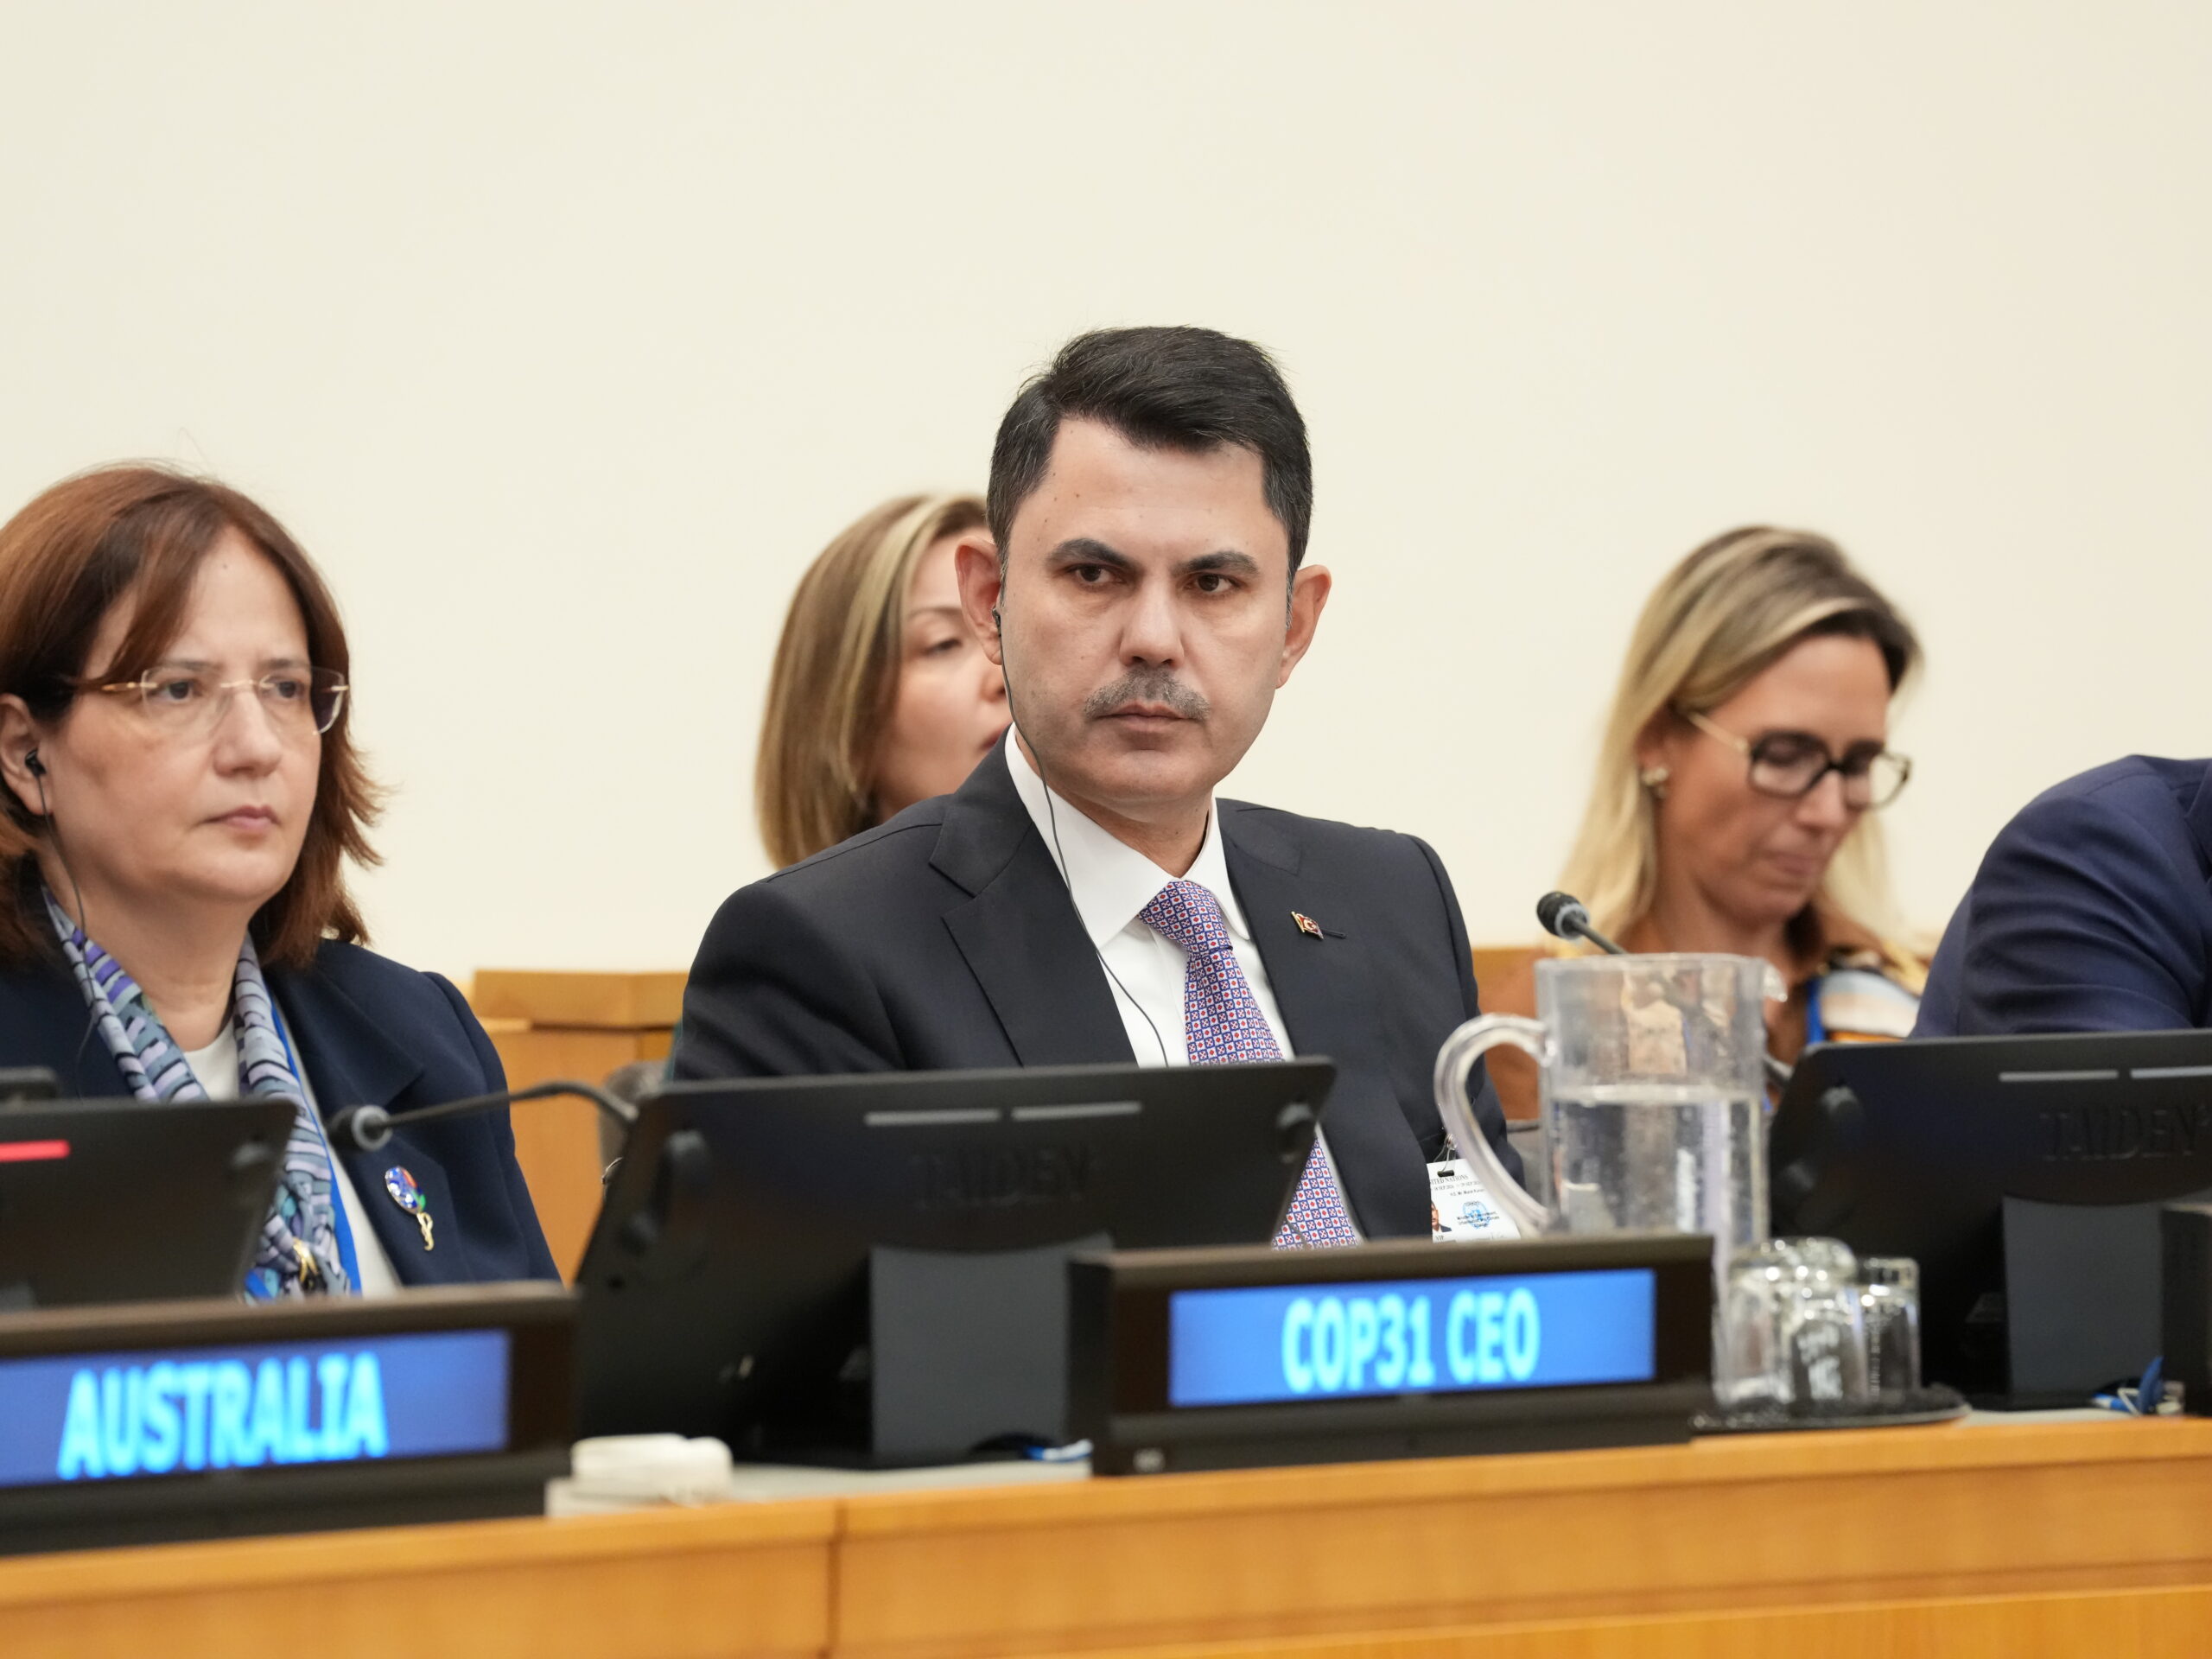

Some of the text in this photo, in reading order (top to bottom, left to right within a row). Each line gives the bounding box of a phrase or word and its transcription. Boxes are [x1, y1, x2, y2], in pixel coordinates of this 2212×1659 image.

[1281, 1287, 1540, 1393] COP31 CEO
[58, 1352, 389, 1479] AUSTRALIA
